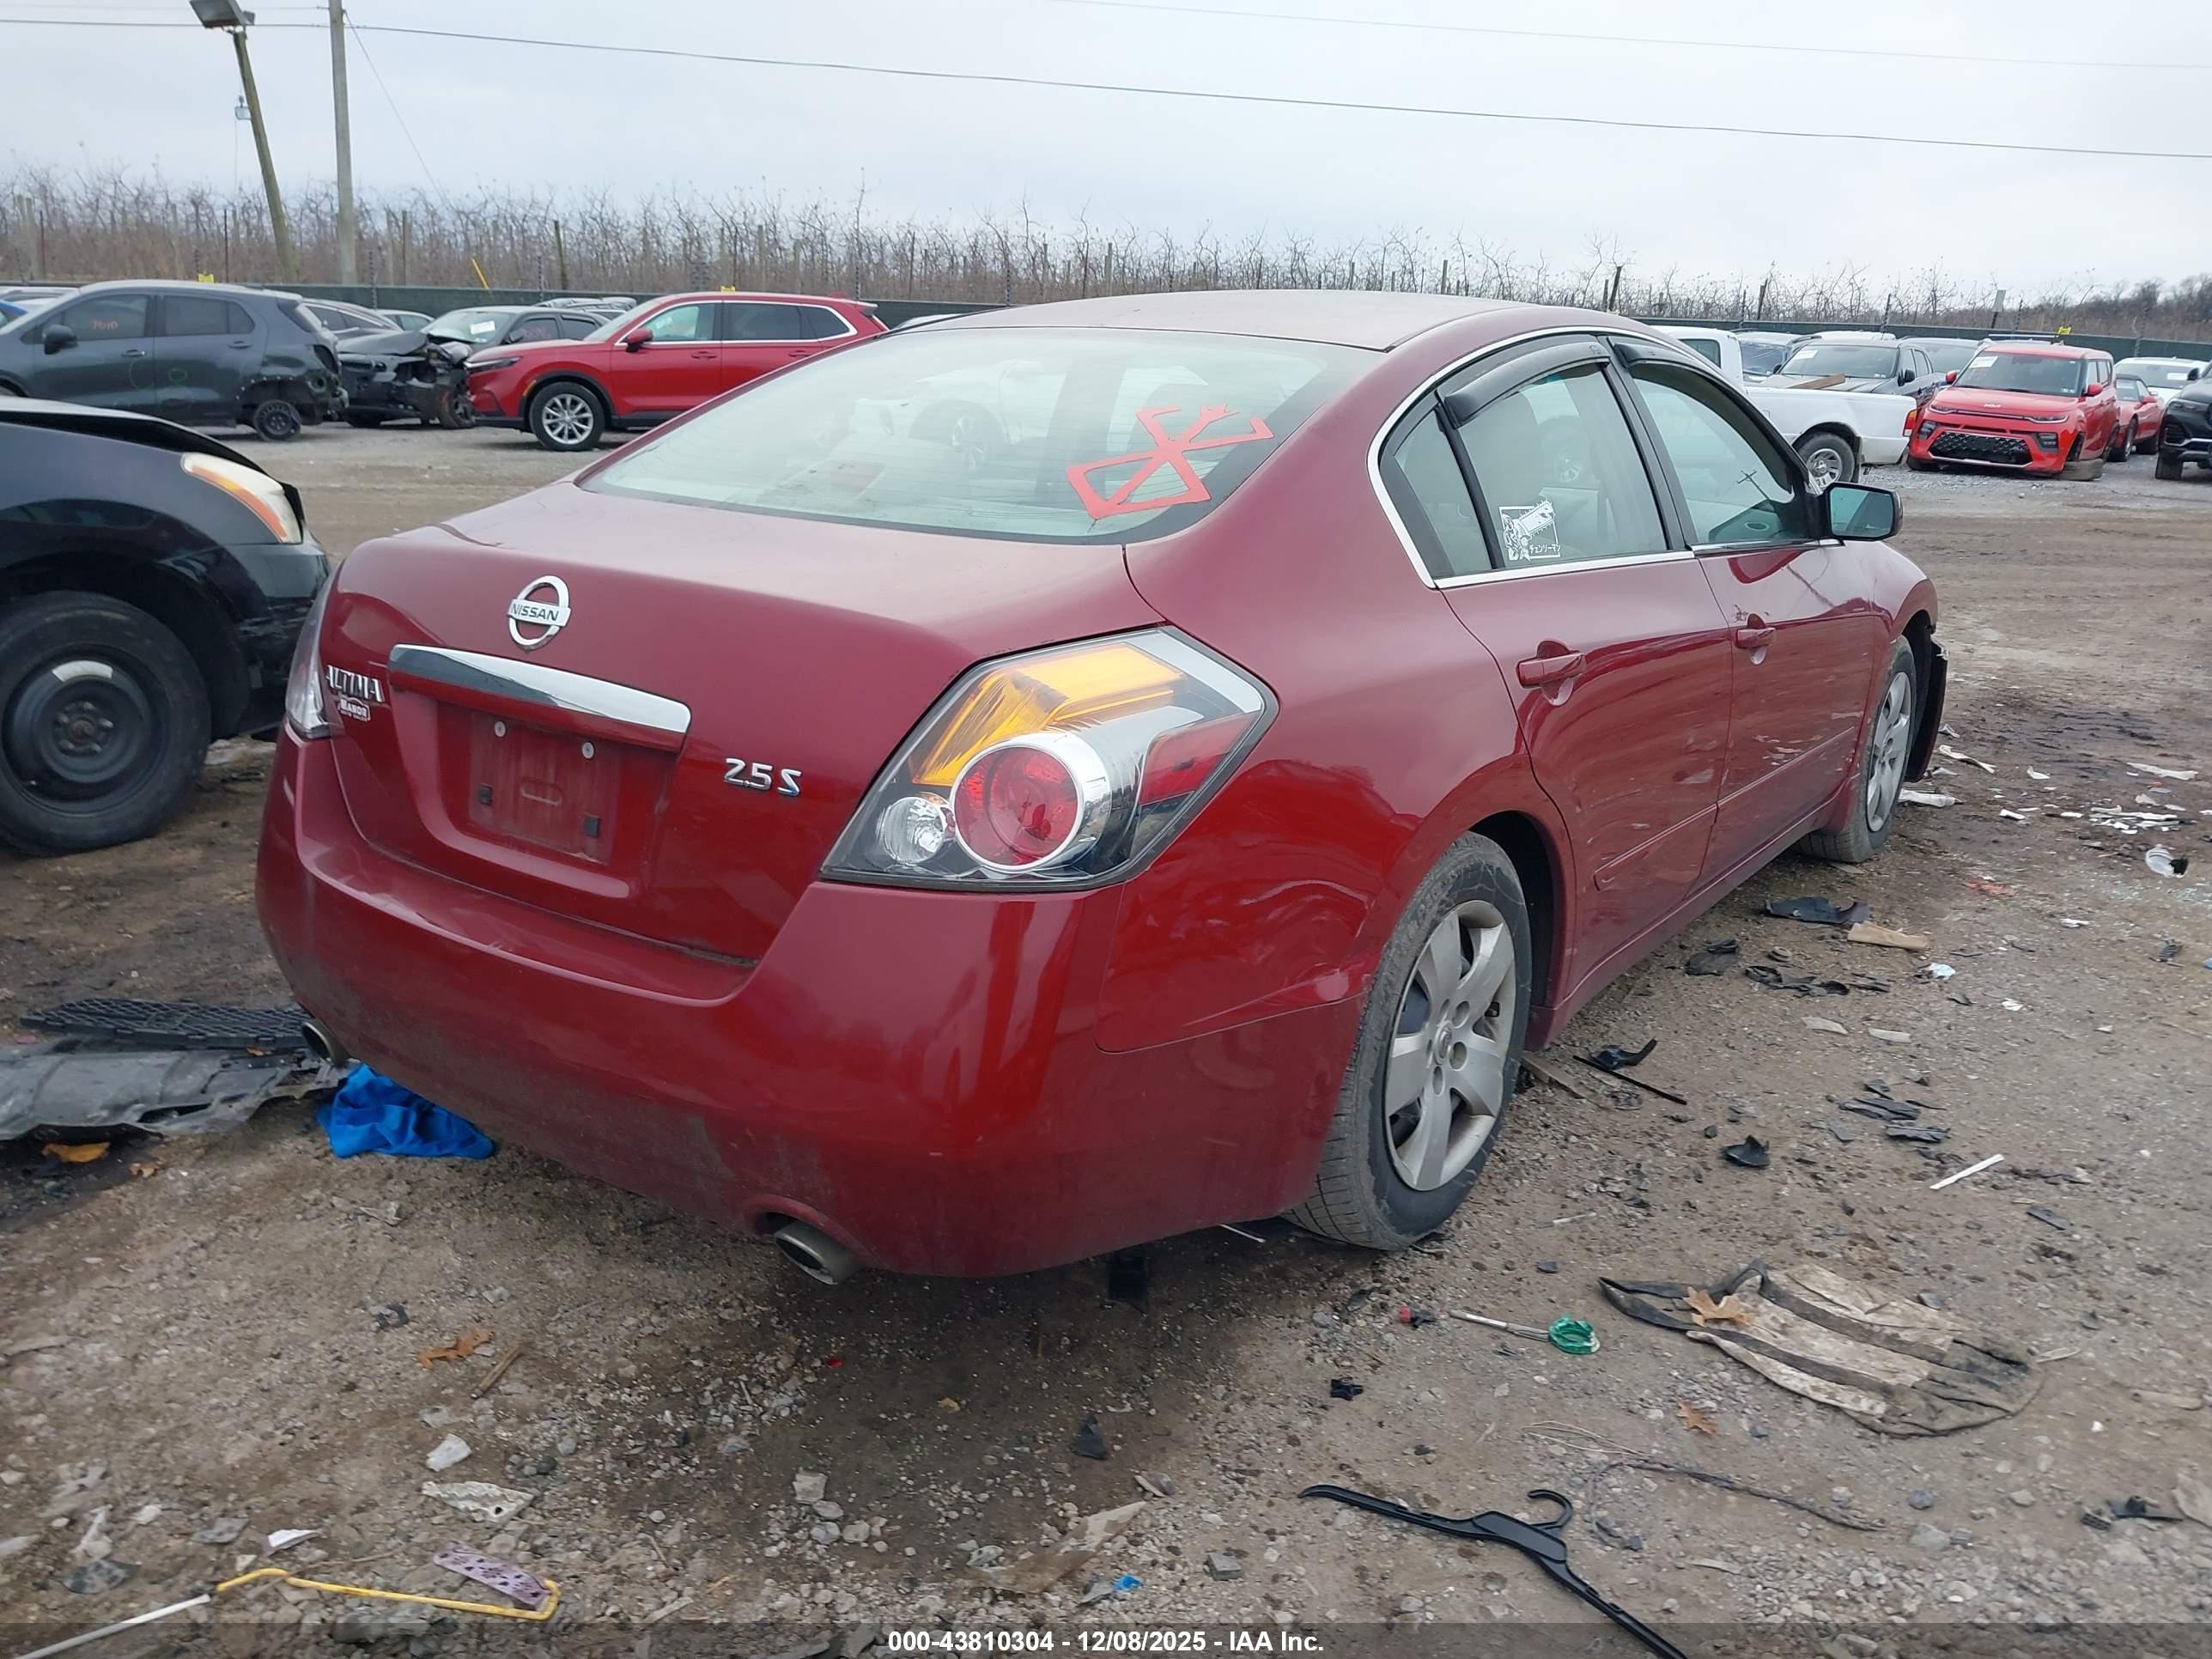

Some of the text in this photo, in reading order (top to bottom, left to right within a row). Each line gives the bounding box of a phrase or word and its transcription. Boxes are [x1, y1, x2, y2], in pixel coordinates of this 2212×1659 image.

[513, 603, 560, 622] NISSAN
[325, 665, 386, 703] ALTIMA
[724, 757, 802, 797] 2.5 S
